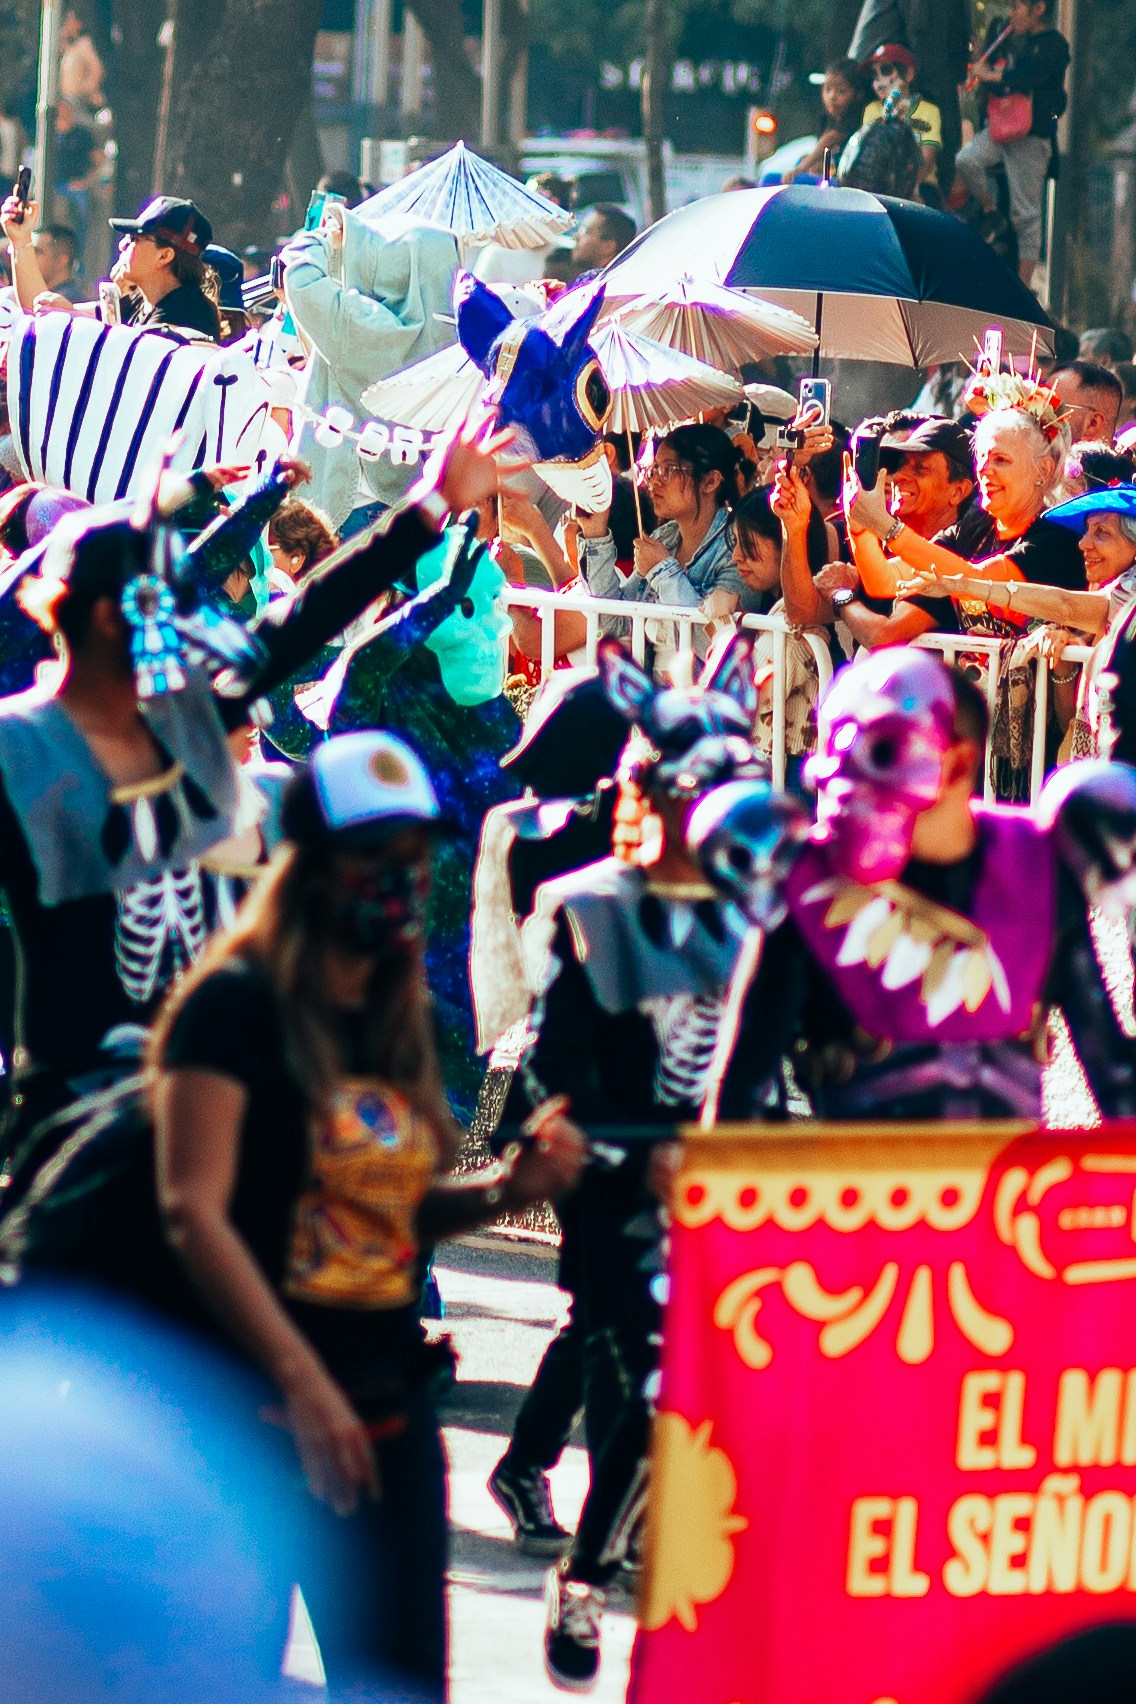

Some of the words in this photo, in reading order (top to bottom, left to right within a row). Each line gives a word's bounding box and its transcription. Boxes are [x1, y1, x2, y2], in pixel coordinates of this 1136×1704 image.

[956, 1369, 1037, 1470] EL
[845, 1496, 930, 1597] EL
[942, 1473, 1136, 1597] SEÑO
